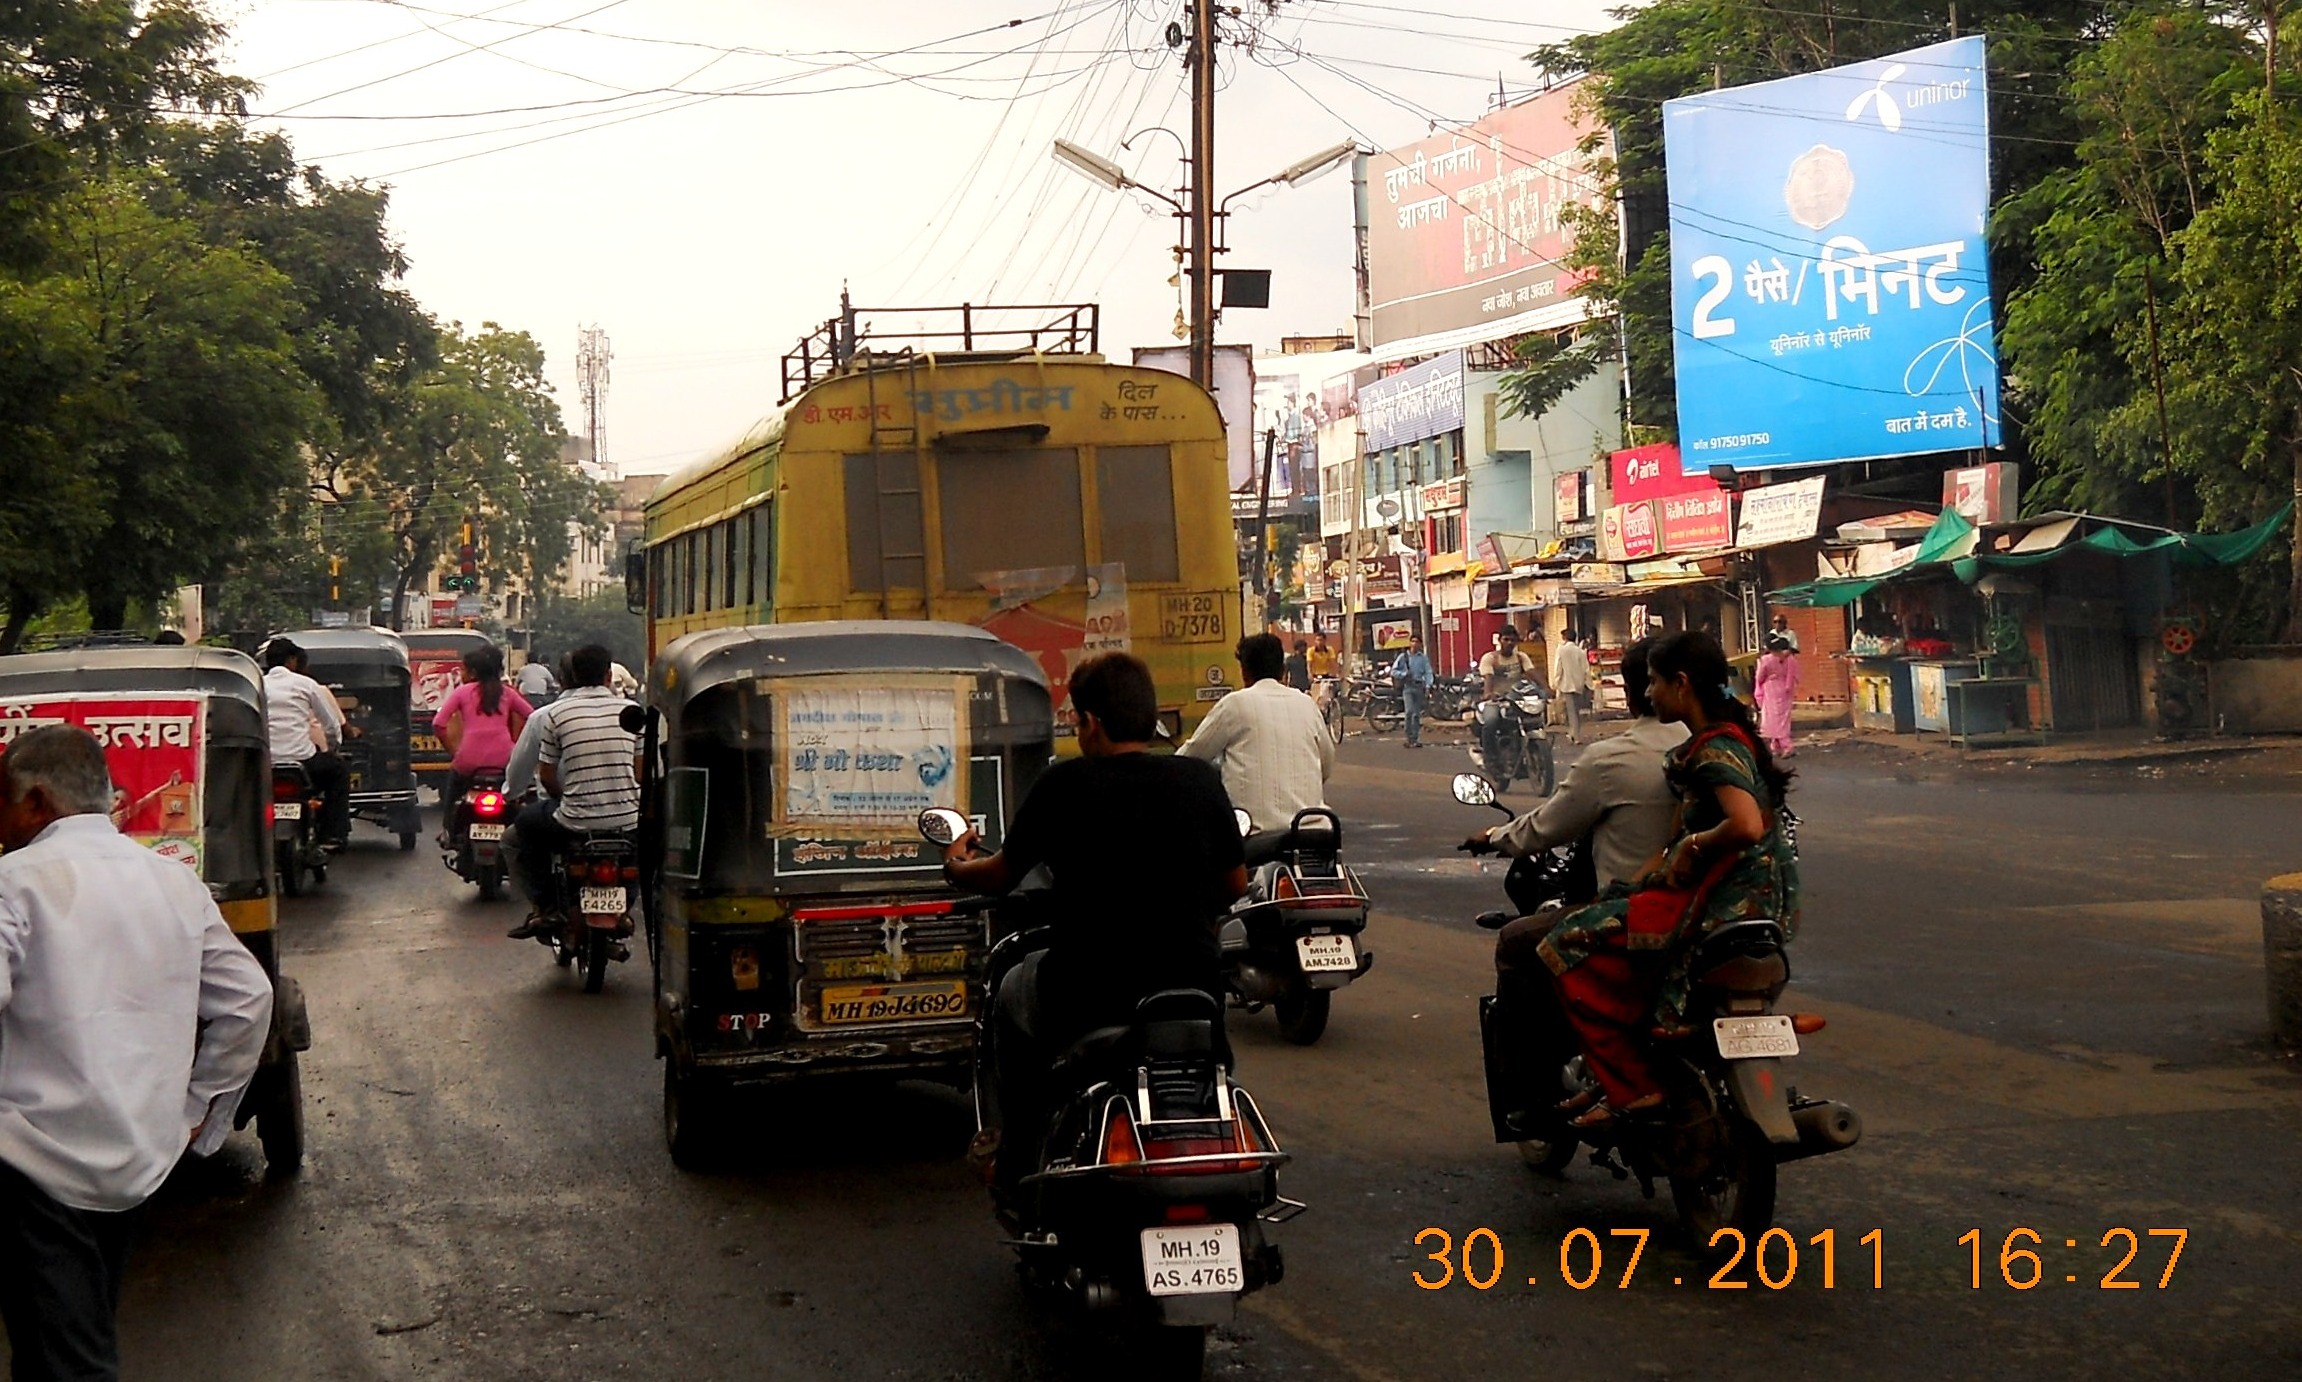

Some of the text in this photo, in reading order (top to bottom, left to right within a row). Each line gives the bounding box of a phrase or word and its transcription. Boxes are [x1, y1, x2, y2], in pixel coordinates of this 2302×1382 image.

[1906, 76, 1971, 109] uninor
[1384, 135, 1481, 203] तुमची गर्जना,
[1396, 195, 1449, 231] आजचा
[1481, 296, 1496, 313] नवा
[1515, 289, 1530, 304] नवा
[1529, 279, 1555, 301] अवतार
[1691, 255, 1736, 339] 2
[1816, 235, 1965, 320] मिनट
[1768, 322, 1872, 356] यूनिनॉर से यूनिनॉर
[1117, 379, 1159, 402] दिल
[1100, 404, 1118, 422] के
[1885, 406, 1972, 435] बात में दम है.
[1638, 457, 1661, 480] airtel
[84, 715, 194, 749] उत्सव
[716, 1012, 772, 1031] STOP
[827, 1002, 863, 1021] MH
[1160, 1238, 1221, 1259] MH.19
[1152, 1267, 1239, 1288] AS.4765
